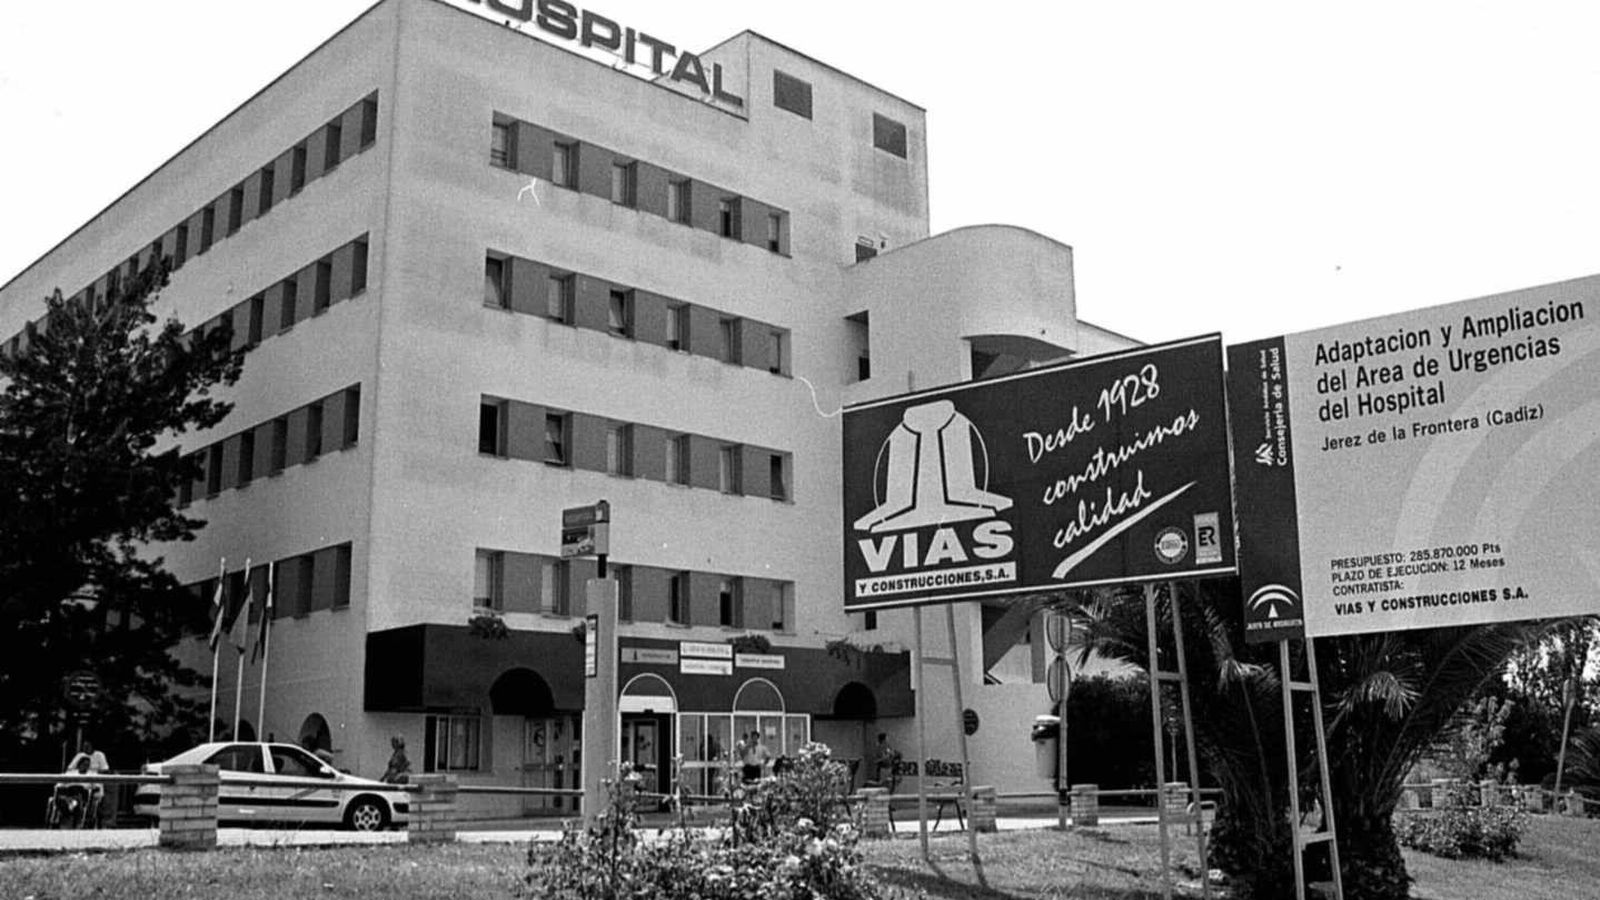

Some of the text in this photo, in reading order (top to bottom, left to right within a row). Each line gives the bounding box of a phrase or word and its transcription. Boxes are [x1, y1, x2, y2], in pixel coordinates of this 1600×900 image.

[1315, 300, 1584, 366] Adaptacion y Ampliacion
[1269, 347, 1281, 380] Salud
[1316, 336, 1561, 394] del Area de Urgencias
[1271, 384, 1282, 398] de
[1318, 380, 1445, 422] del Hospital
[1023, 363, 1160, 463] Desde 1928
[1321, 403, 1544, 452] Jerez de la Frontera (Cadiz)
[1043, 408, 1200, 505] construimos
[1053, 469, 1151, 548] calidad
[858, 520, 1014, 573] VIAS
[1331, 553, 1406, 570] PRESUPUESTO:
[1482, 543, 1501, 555] Pts
[859, 583, 867, 594] Y
[1331, 556, 1505, 583] PLAZO DE EJECUCION: 12 Meses
[1332, 580, 1405, 596] CONTRATISTA:
[1334, 586, 1529, 616] VIAS Y CONSTRUCCIONES S.A.
